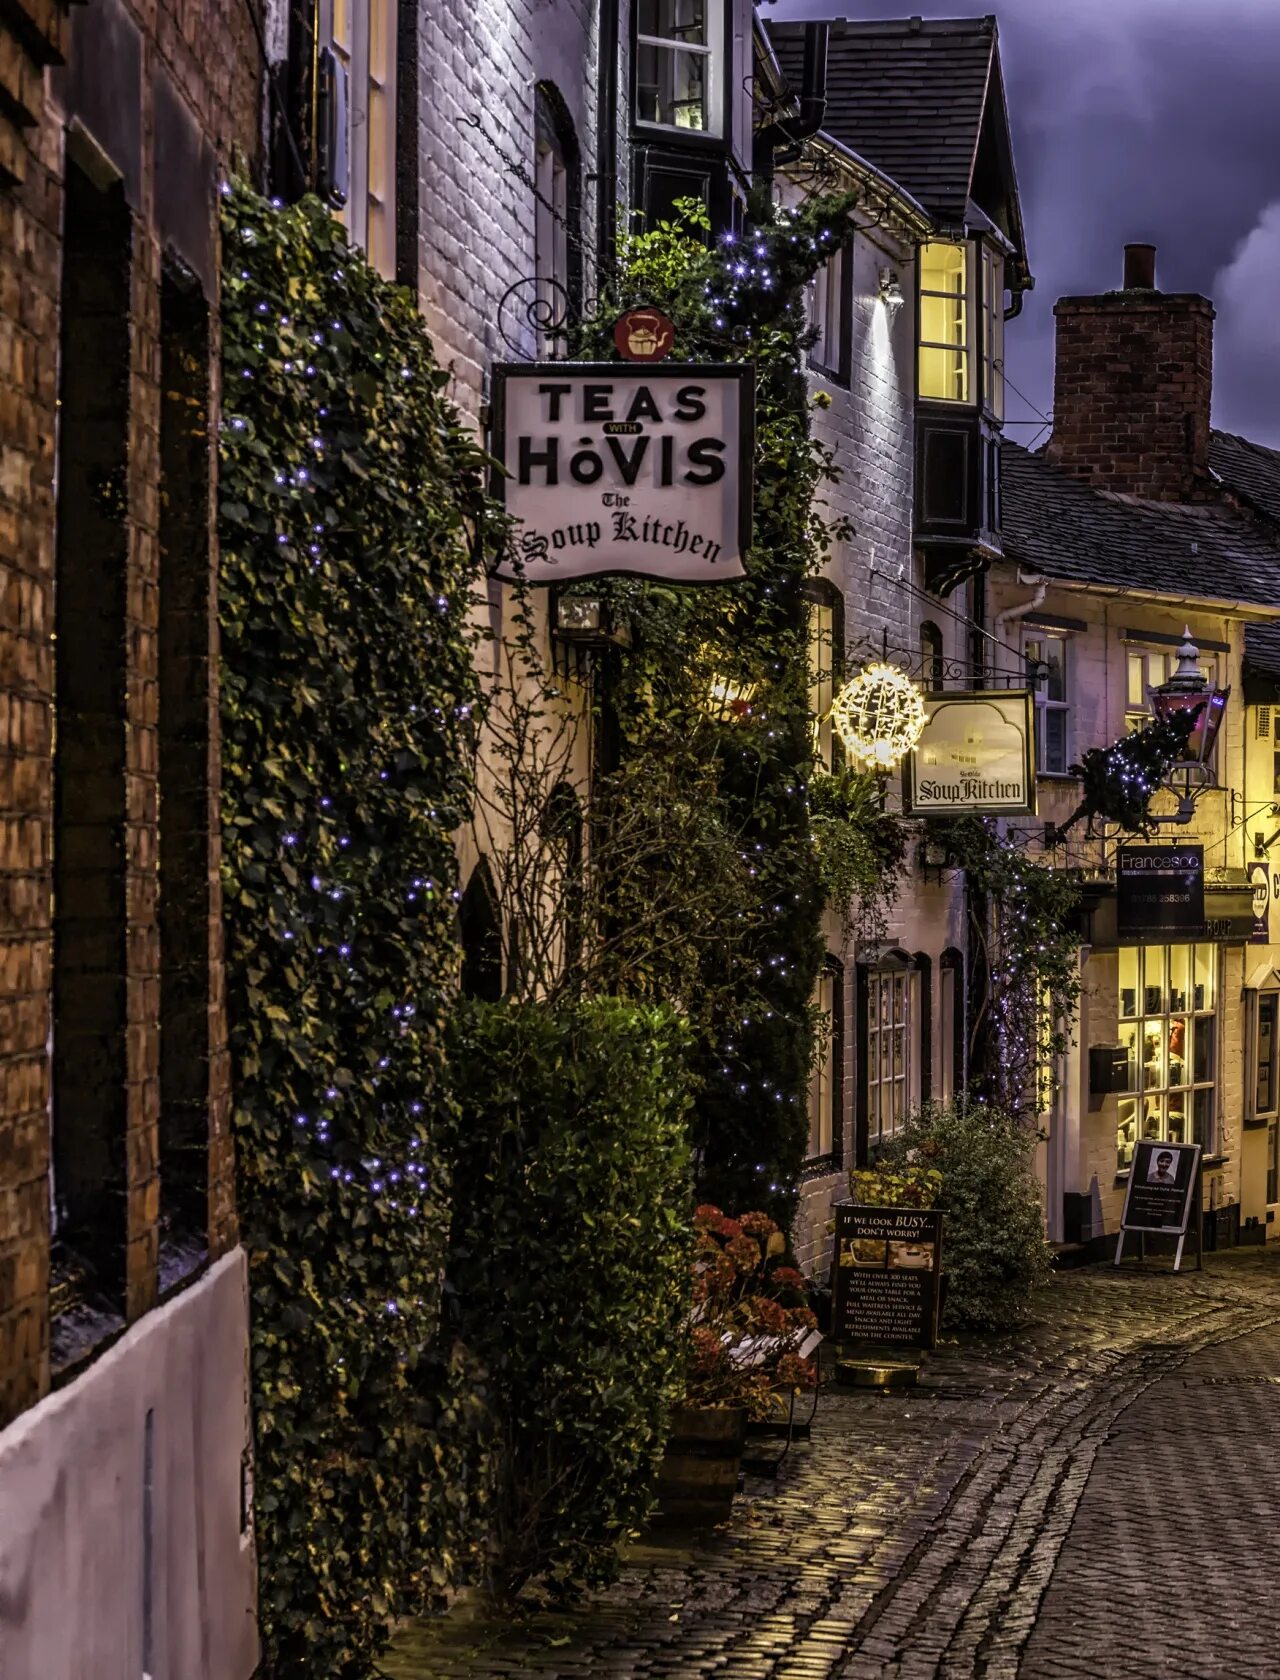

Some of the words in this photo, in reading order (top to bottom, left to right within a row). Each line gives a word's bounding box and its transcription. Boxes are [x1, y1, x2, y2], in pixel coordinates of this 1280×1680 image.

[539, 384, 706, 422] TEAS
[609, 424, 636, 433] WITH
[602, 493, 630, 508] The
[521, 521, 600, 564] Soup
[611, 511, 722, 563] Kitchen
[920, 780, 959, 802] Soup
[960, 778, 1020, 802] Kitchen
[1121, 853, 1199, 868] Francesco
[1204, 919, 1232, 936] ROUP
[843, 1216, 851, 1224] IF
[869, 1218, 892, 1226] LOOK
[895, 1216, 934, 1228] BUSY...
[857, 1227, 884, 1235] DON'T
[886, 1229, 919, 1238] WORRY!
[853, 1271, 871, 1279] WITH
